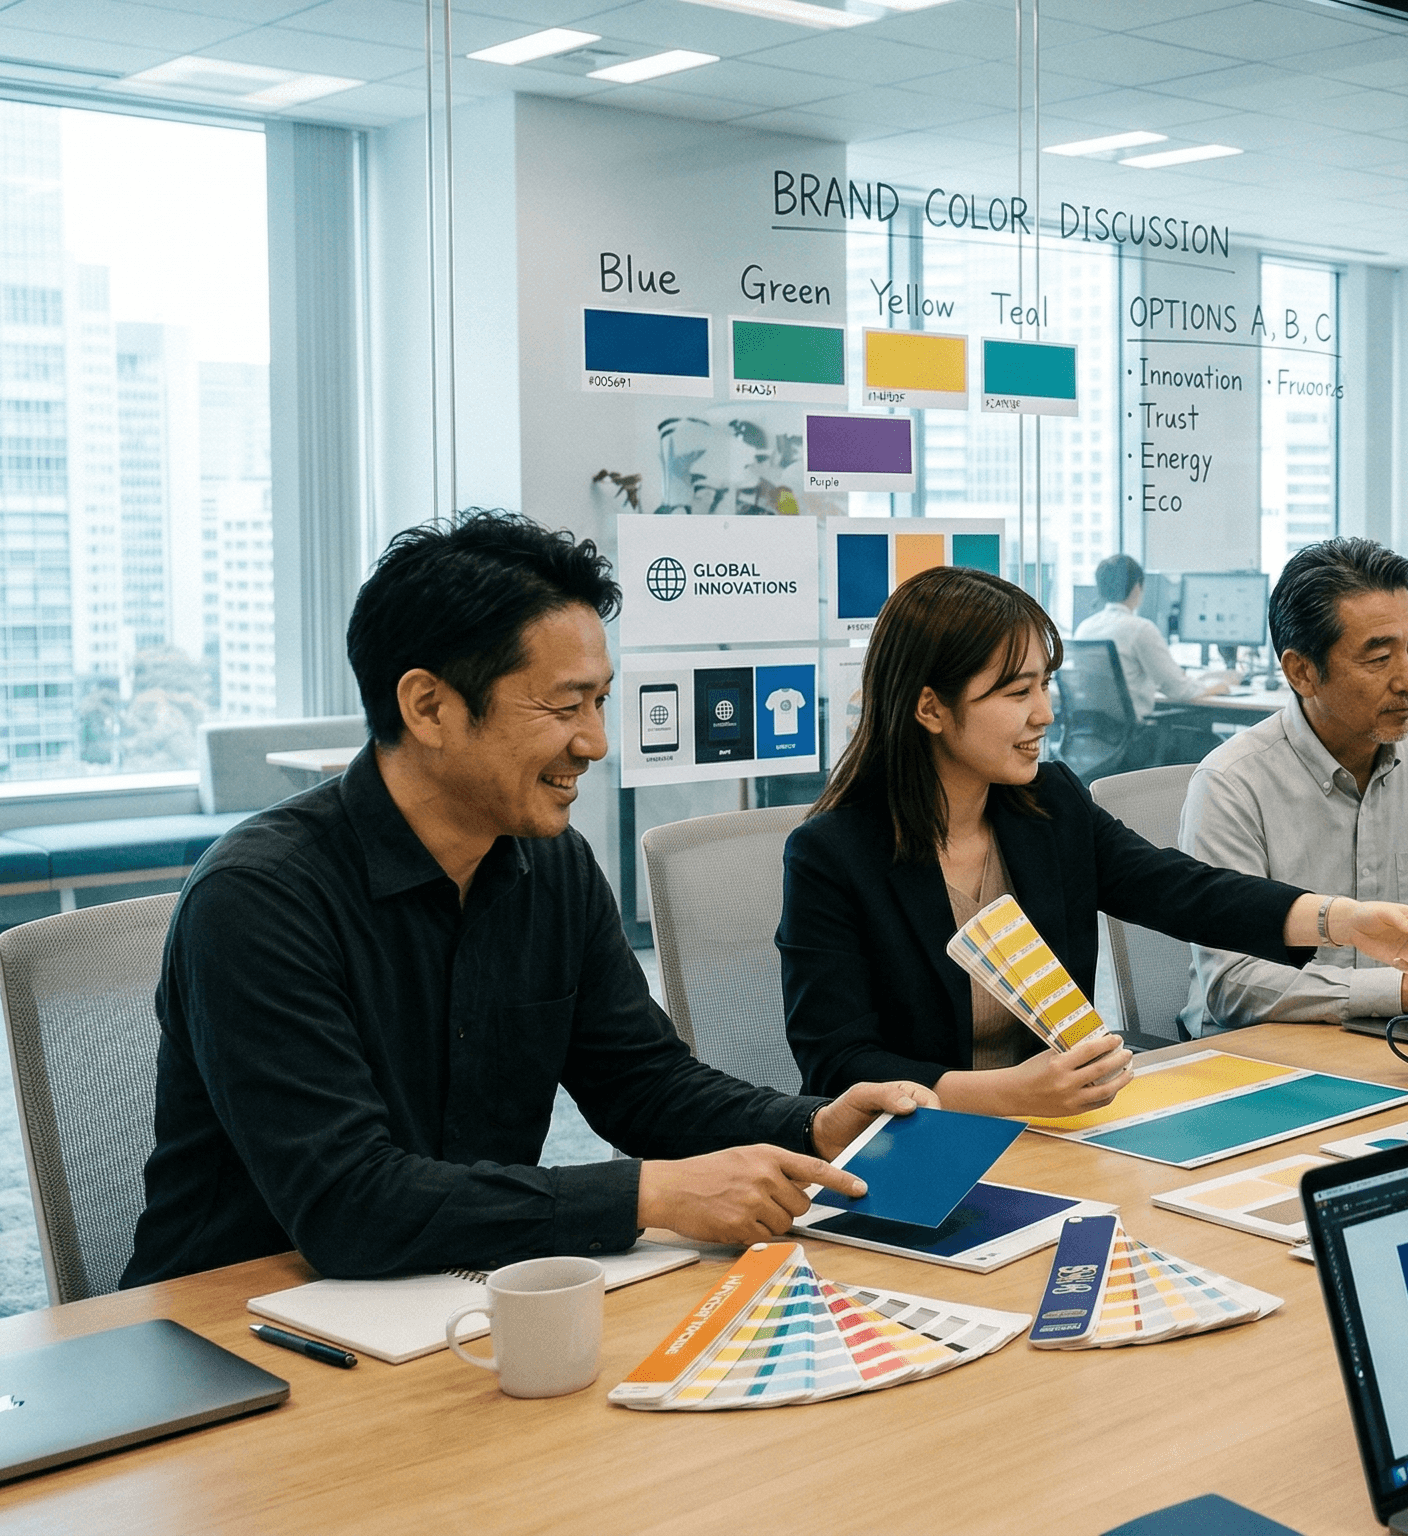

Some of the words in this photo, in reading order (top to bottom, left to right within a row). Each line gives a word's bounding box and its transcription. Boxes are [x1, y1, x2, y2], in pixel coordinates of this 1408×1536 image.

[773, 170, 899, 223] BRAND
[925, 188, 1031, 235] COLOR
[1060, 202, 1230, 258] DISCUSSION
[600, 252, 680, 295] Blue
[741, 264, 830, 305] Green
[870, 278, 954, 318] Yellow
[991, 292, 1047, 327] Teal
[1130, 296, 1237, 333] OPTIONS
[1315, 313, 1332, 342] C
[1139, 357, 1243, 392] Innovation
[1139, 402, 1199, 431] Trust
[1140, 442, 1213, 482] Energy
[810, 477, 839, 489] Purple
[1142, 484, 1182, 512] Eco
[693, 563, 761, 577] GLOBAL
[694, 581, 797, 595] INNOVATIONS
